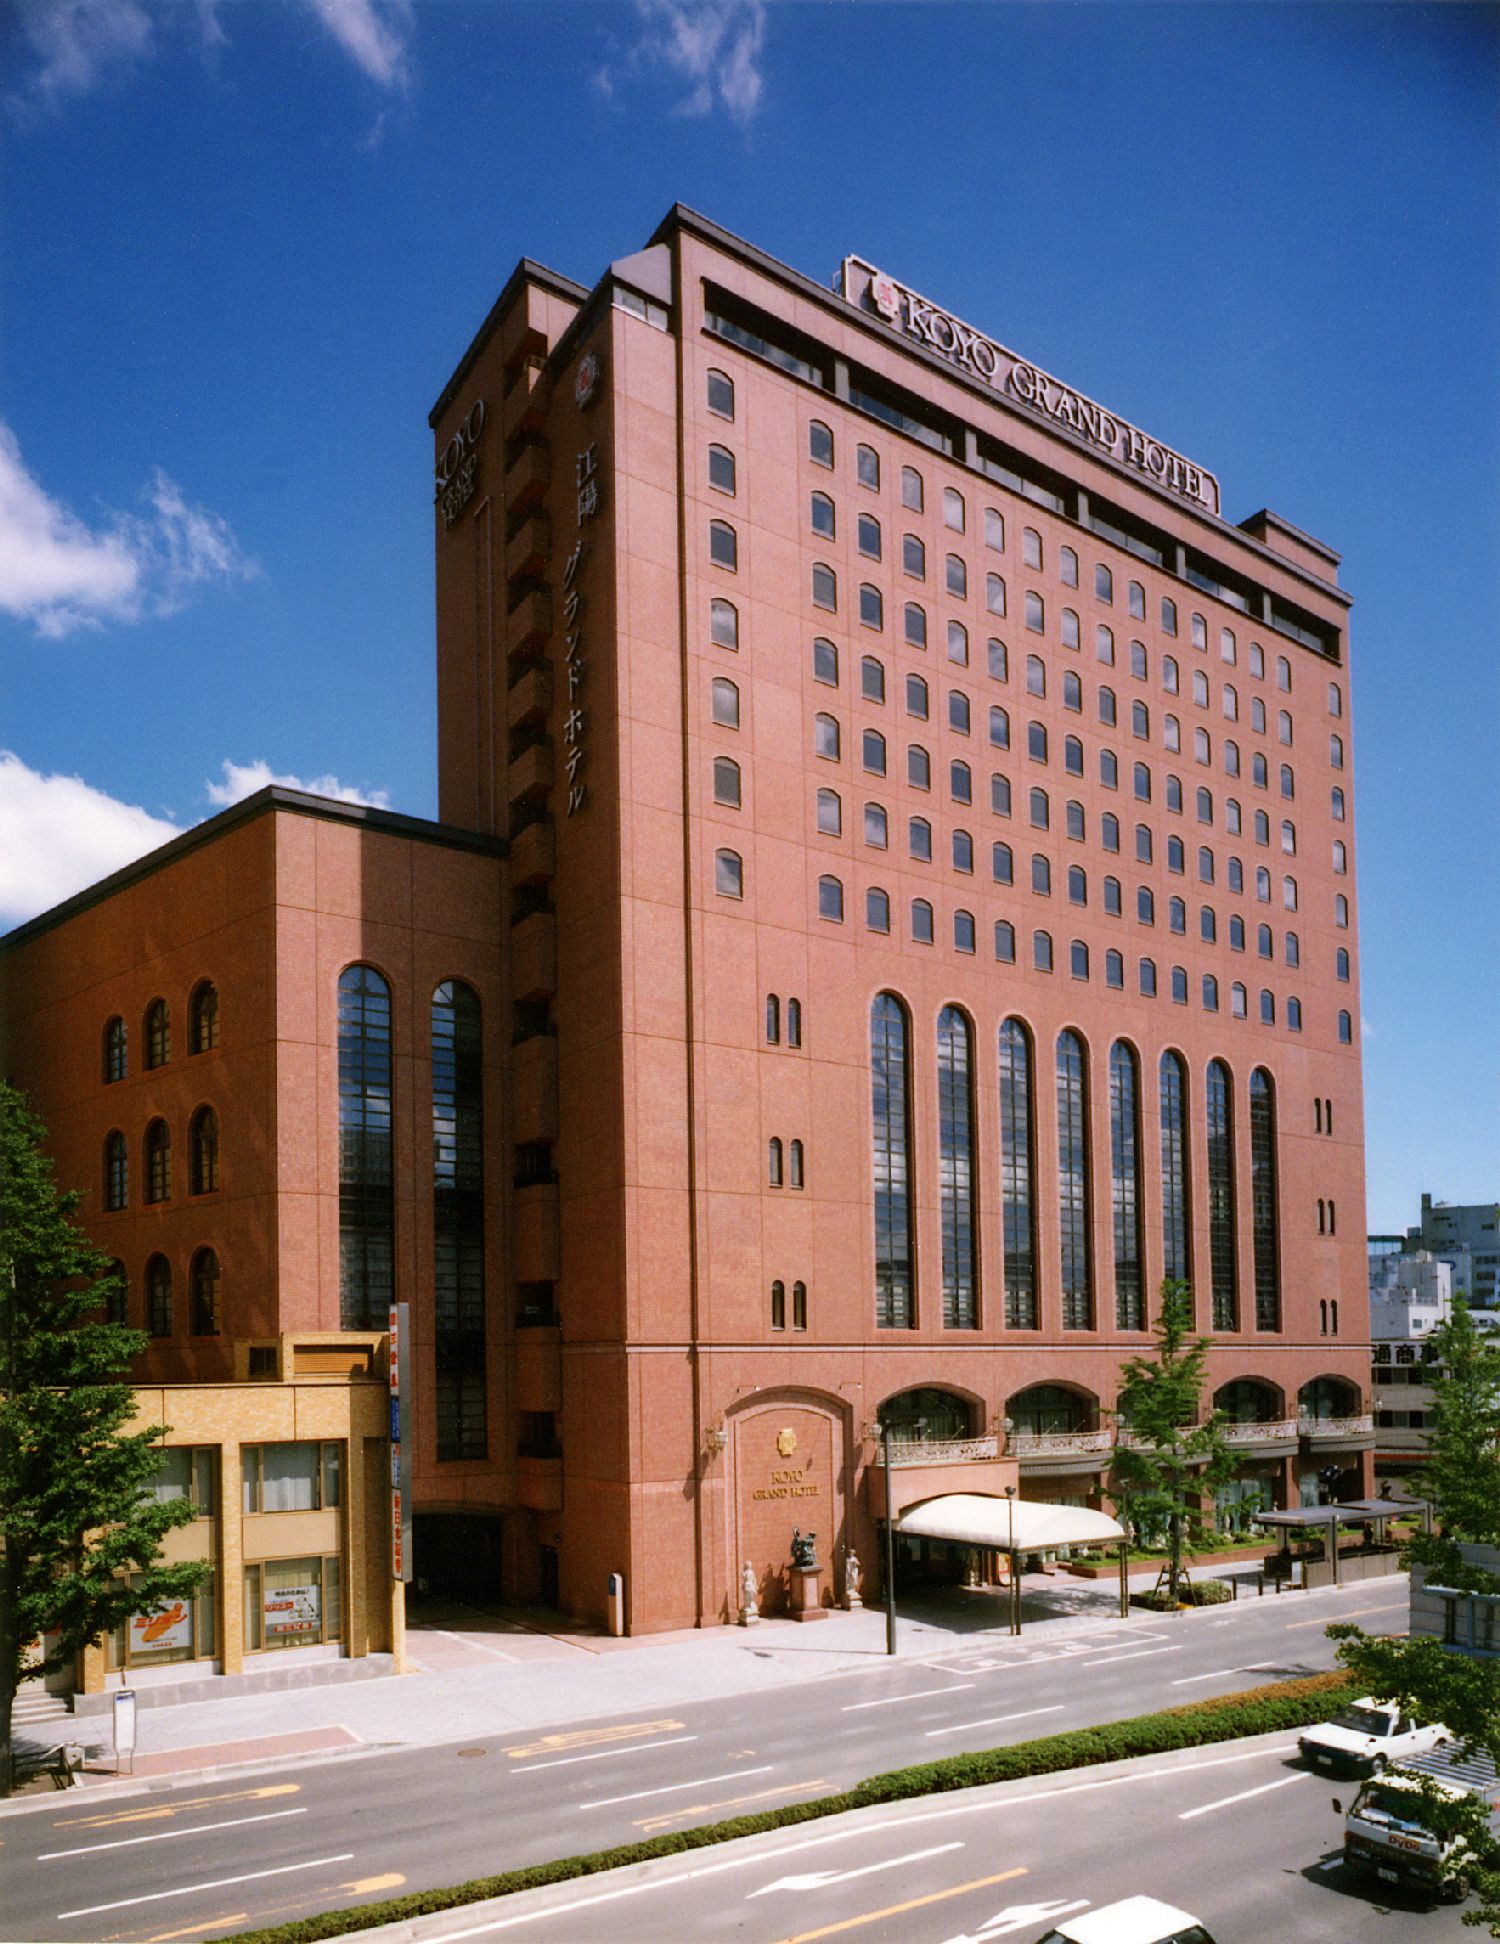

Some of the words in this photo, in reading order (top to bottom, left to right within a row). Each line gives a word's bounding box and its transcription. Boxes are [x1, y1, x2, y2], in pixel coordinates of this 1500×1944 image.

[905, 293, 998, 378] KOYO
[1010, 362, 1119, 448] GRAND
[1126, 428, 1211, 505] HOTEL
[575, 441, 599, 528] 江陽
[562, 539, 583, 819] グランドホテル
[752, 1488, 788, 1500] GRAND
[790, 1486, 820, 1498] HOTEL
[771, 1470, 803, 1485] KOYO
